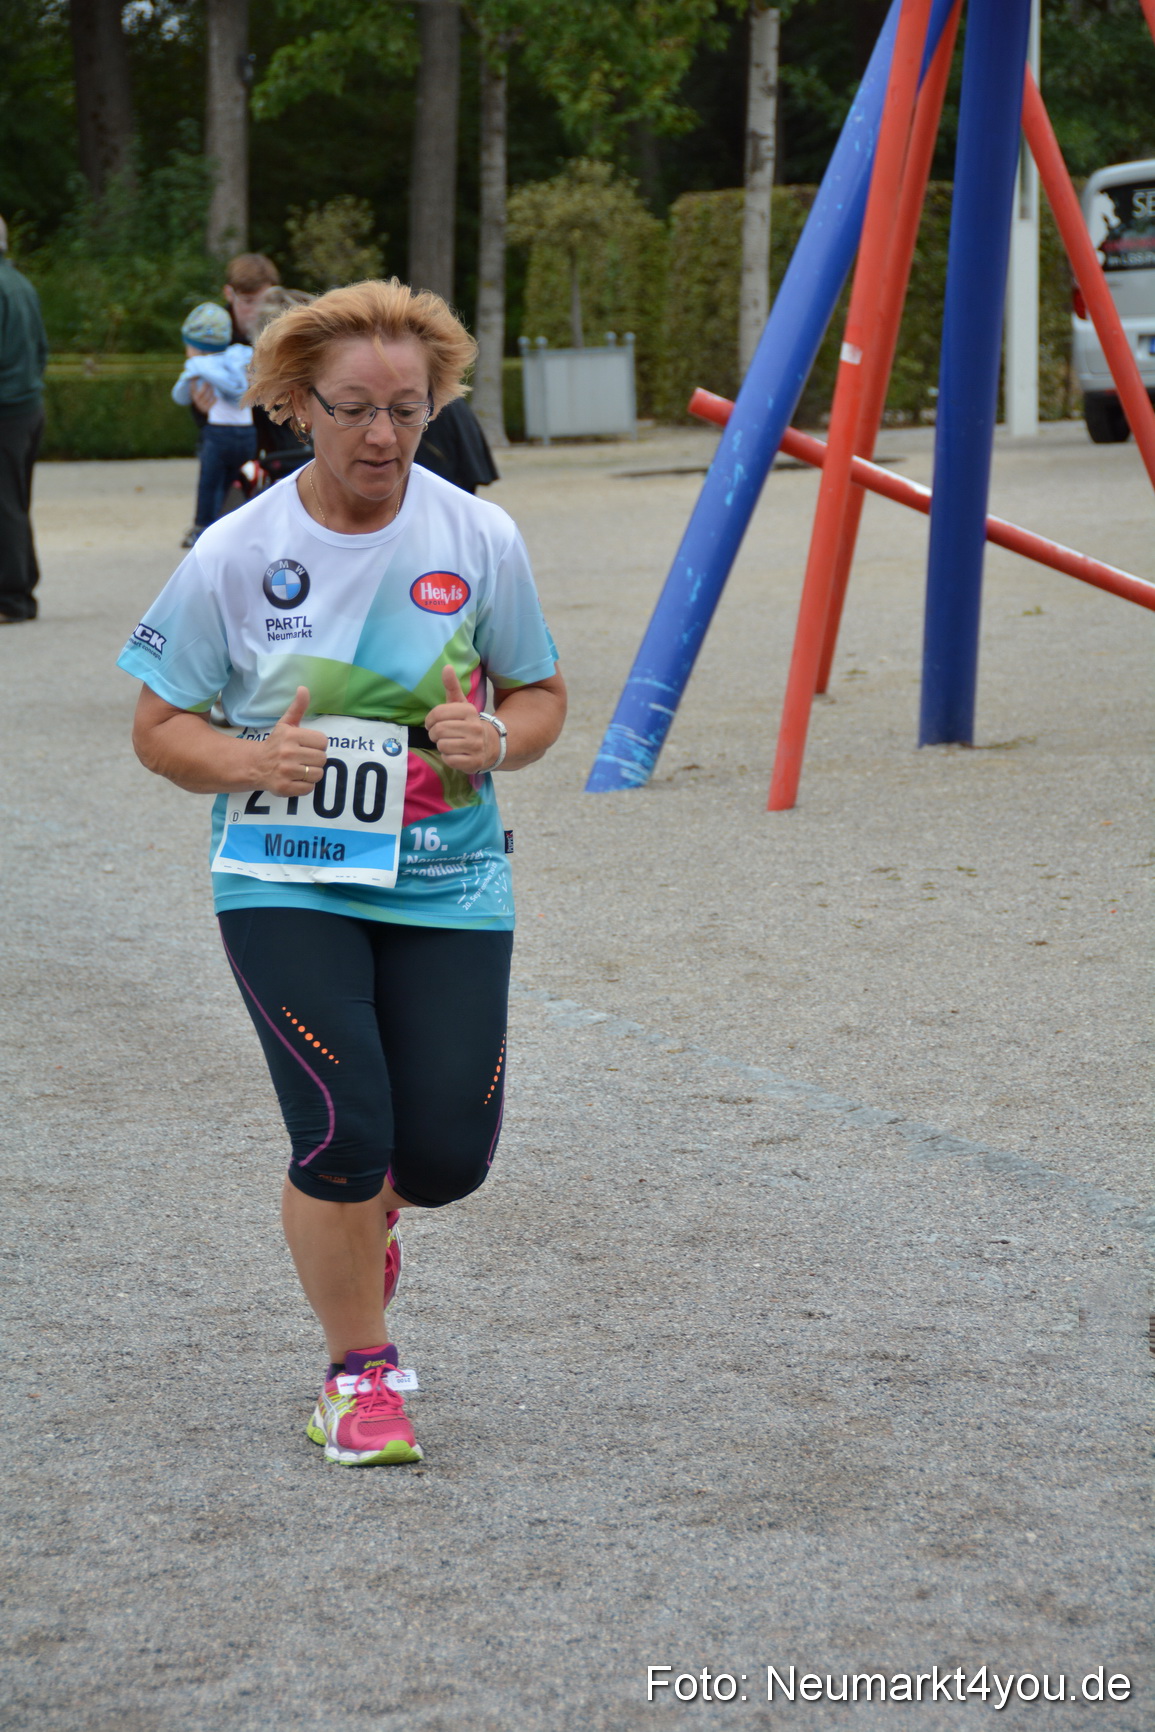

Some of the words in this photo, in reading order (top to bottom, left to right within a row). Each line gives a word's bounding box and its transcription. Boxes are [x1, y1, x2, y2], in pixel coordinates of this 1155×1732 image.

[266, 560, 306, 577] BMW
[420, 582, 463, 604] Hervis
[265, 615, 313, 632] PARTL
[133, 623, 167, 655] CK
[267, 628, 313, 642] Neumarkt
[328, 736, 375, 752] markt
[232, 812, 240, 822] D
[265, 833, 346, 862] Monika
[410, 826, 449, 852] 16.
